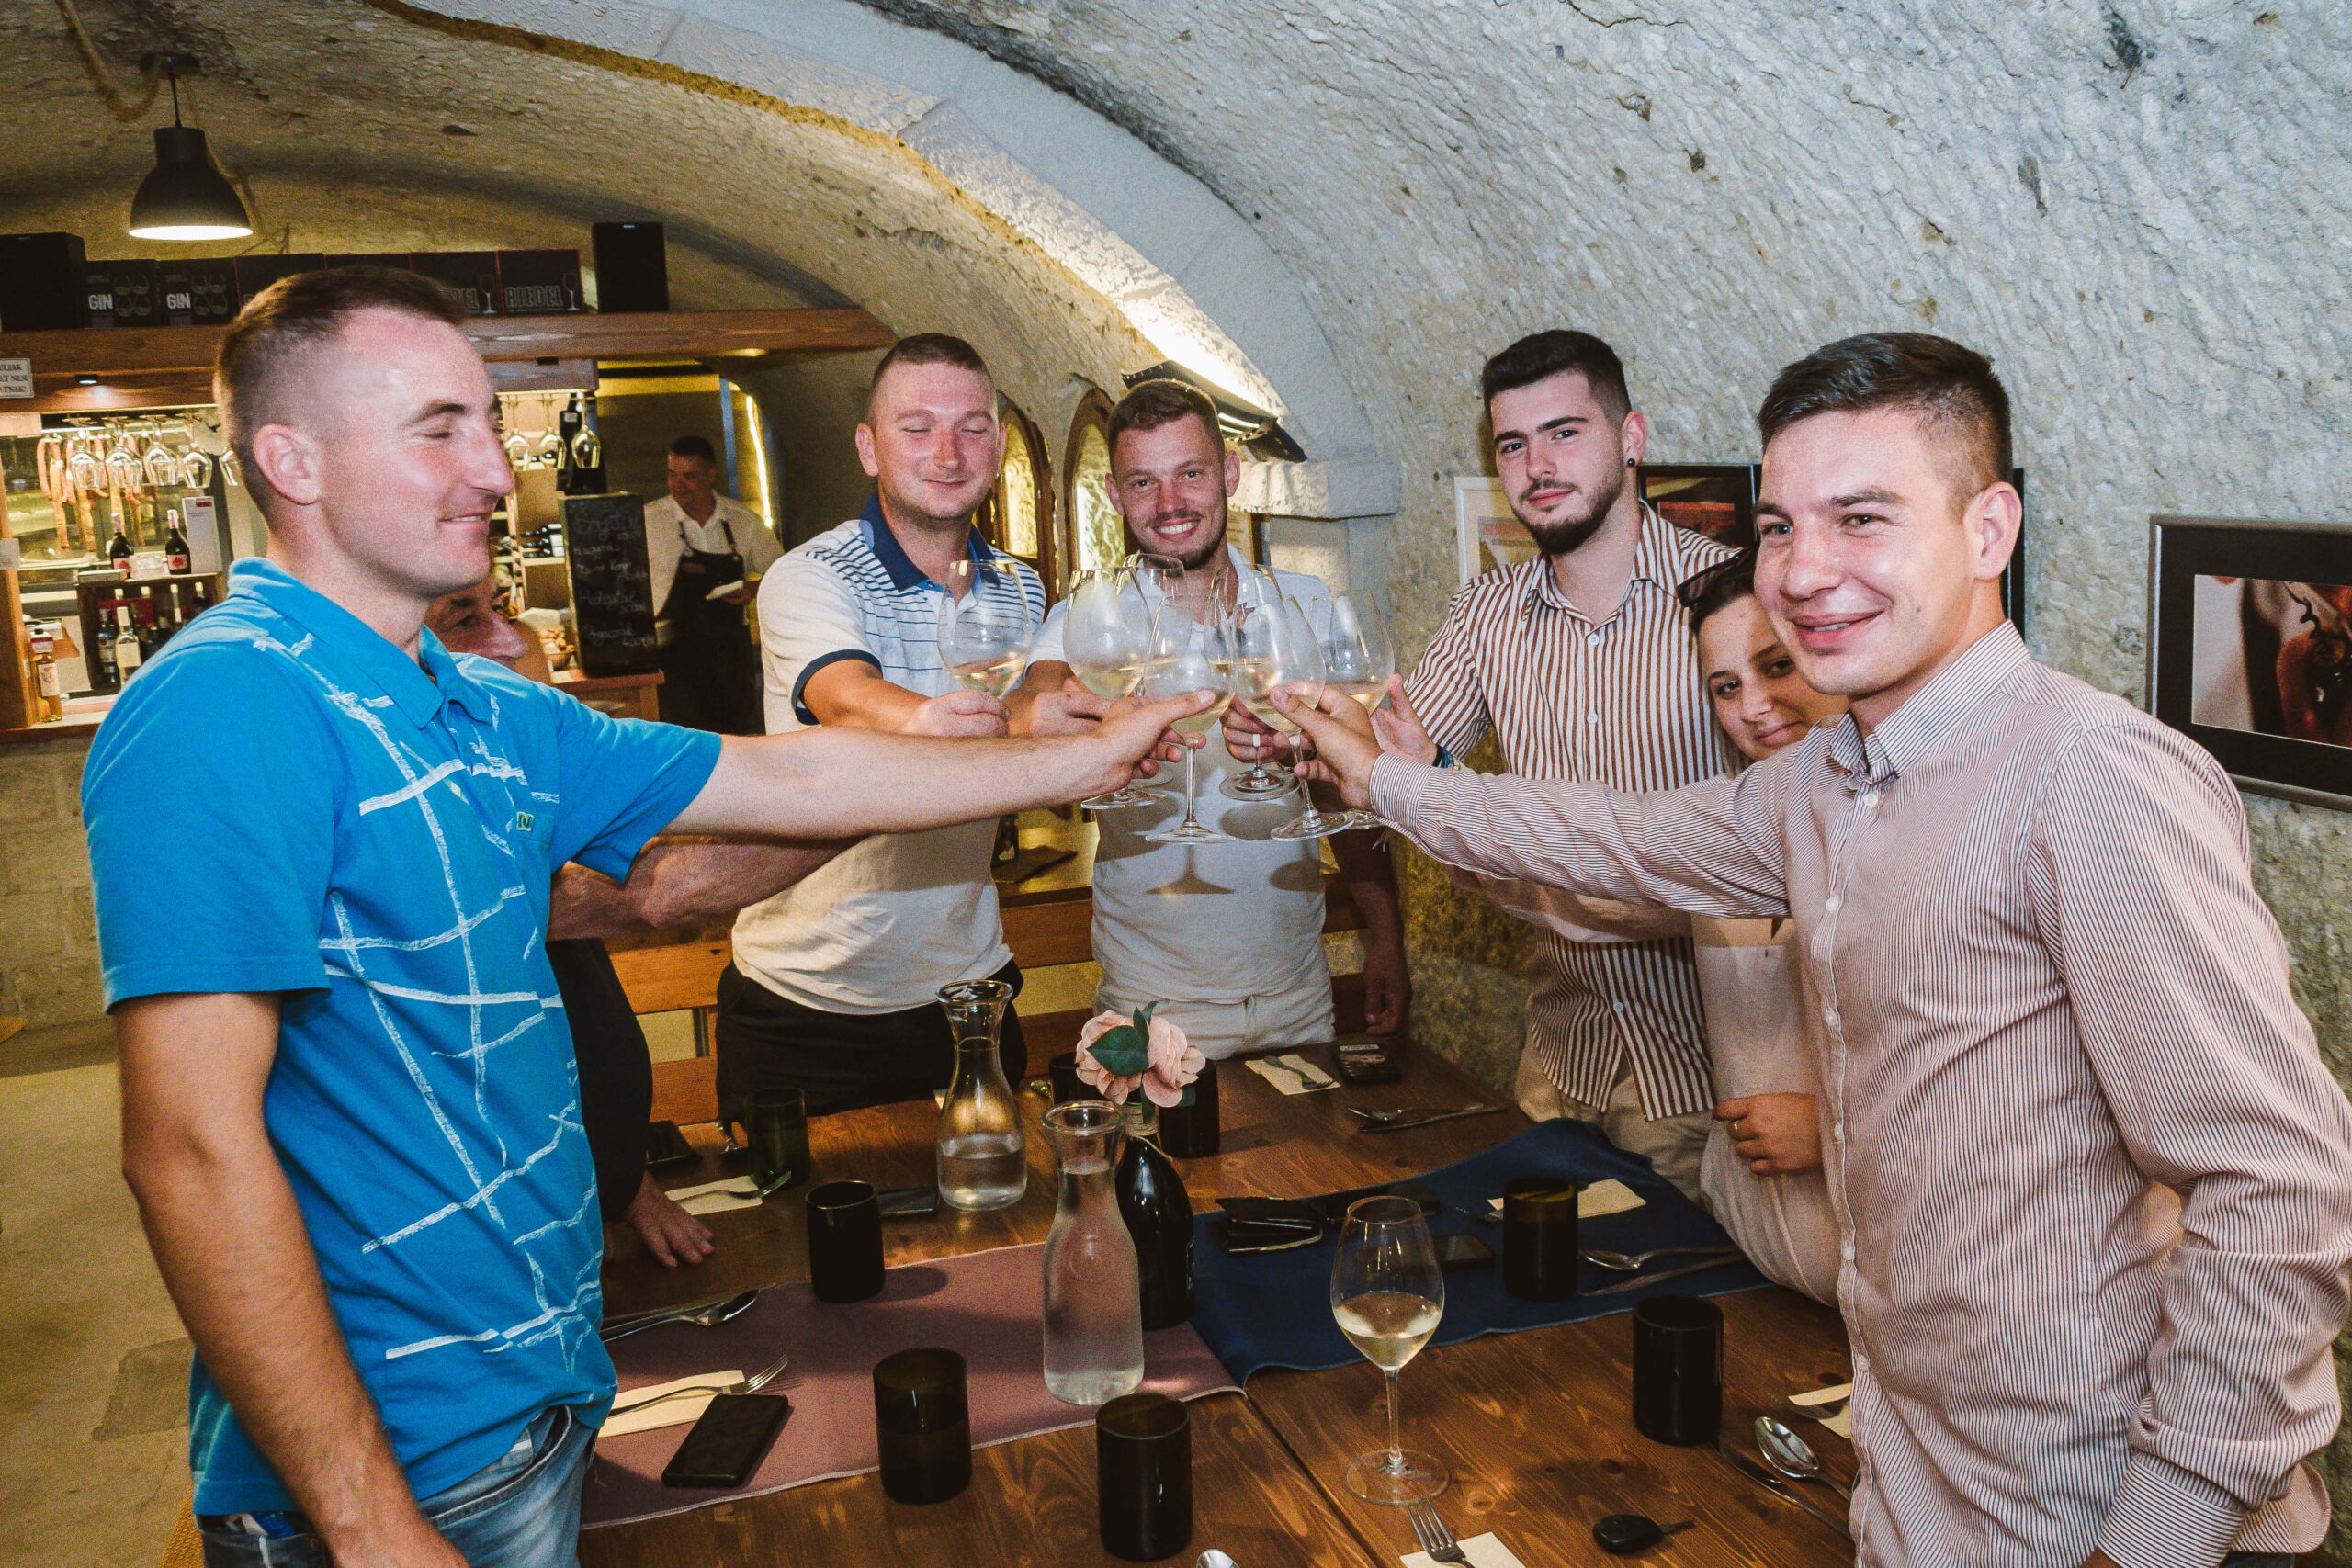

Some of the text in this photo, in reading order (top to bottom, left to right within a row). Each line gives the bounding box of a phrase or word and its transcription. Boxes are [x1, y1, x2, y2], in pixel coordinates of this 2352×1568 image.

[88, 294, 113, 310] GIN
[166, 292, 191, 309] GIN
[505, 286, 563, 307] RIEDEL
